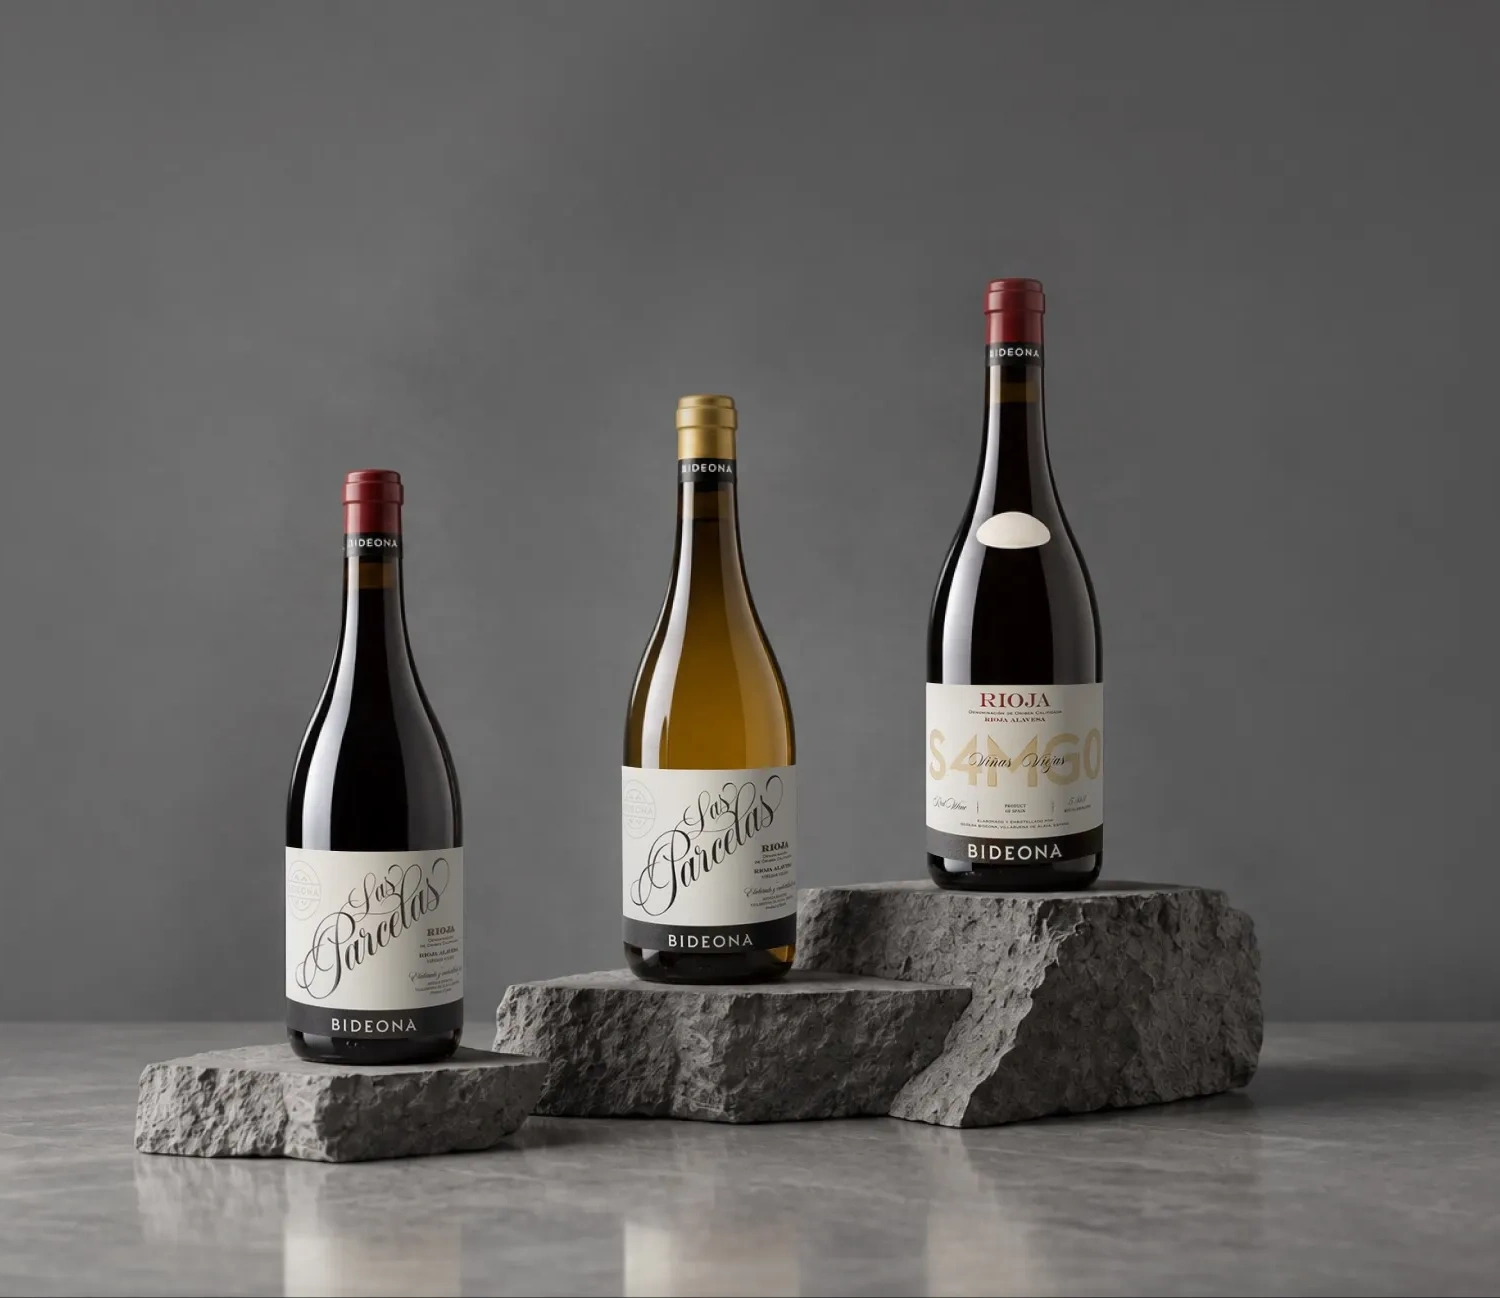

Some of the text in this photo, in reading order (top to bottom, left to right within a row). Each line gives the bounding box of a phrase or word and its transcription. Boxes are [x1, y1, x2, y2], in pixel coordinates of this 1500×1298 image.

[979, 691, 1051, 708] RIOJA
[968, 752, 1012, 768] Viñas
[683, 782, 738, 840] Las
[630, 775, 784, 916] Parcelas
[761, 841, 789, 852] RIOJA
[967, 843, 1063, 861] BIDEONA
[348, 864, 404, 922] Las
[296, 858, 449, 999] Parcelas
[426, 925, 455, 936] RIOJA
[668, 934, 753, 949] BIDEONA
[331, 1018, 417, 1034] BIDEONA
